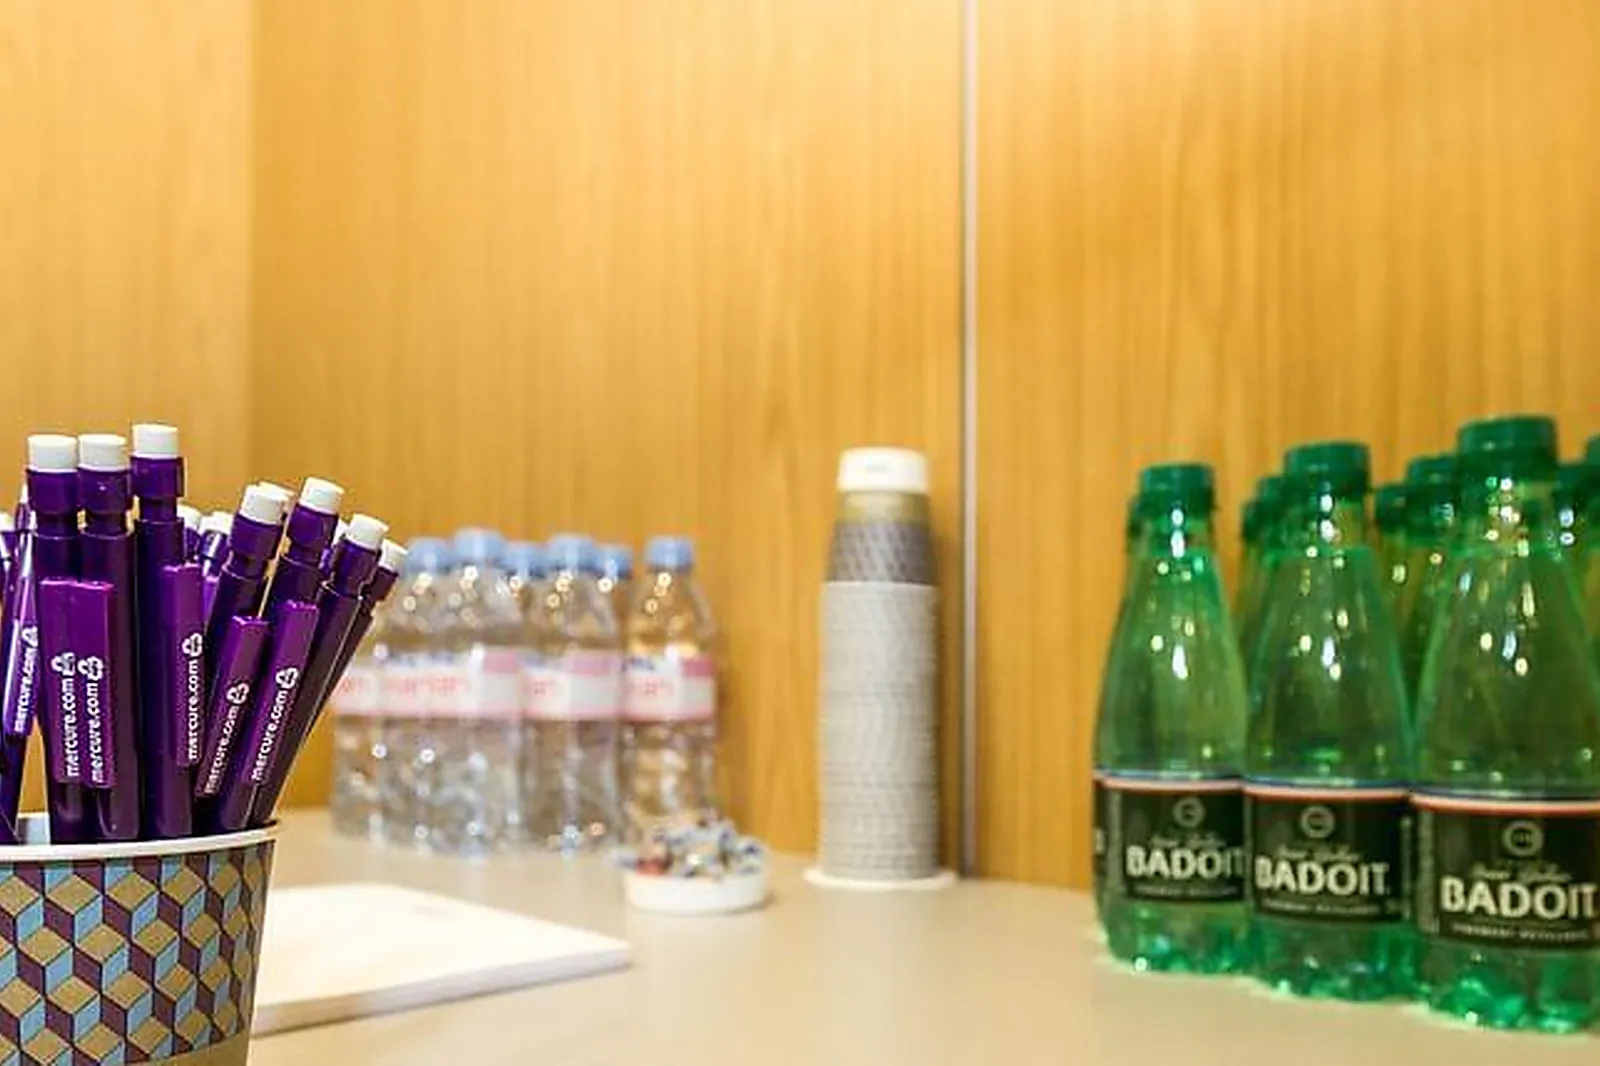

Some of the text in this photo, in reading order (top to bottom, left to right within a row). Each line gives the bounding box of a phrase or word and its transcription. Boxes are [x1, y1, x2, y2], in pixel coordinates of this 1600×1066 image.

[62, 675, 79, 777] mercure.com
[85, 681, 105, 784] mercure.com
[185, 657, 200, 760] mercure.com
[203, 704, 240, 794] mercure.com
[250, 688, 288, 781] mercure.com
[1254, 855, 1390, 896] BADOIT
[1440, 874, 1598, 919] BADOIT
